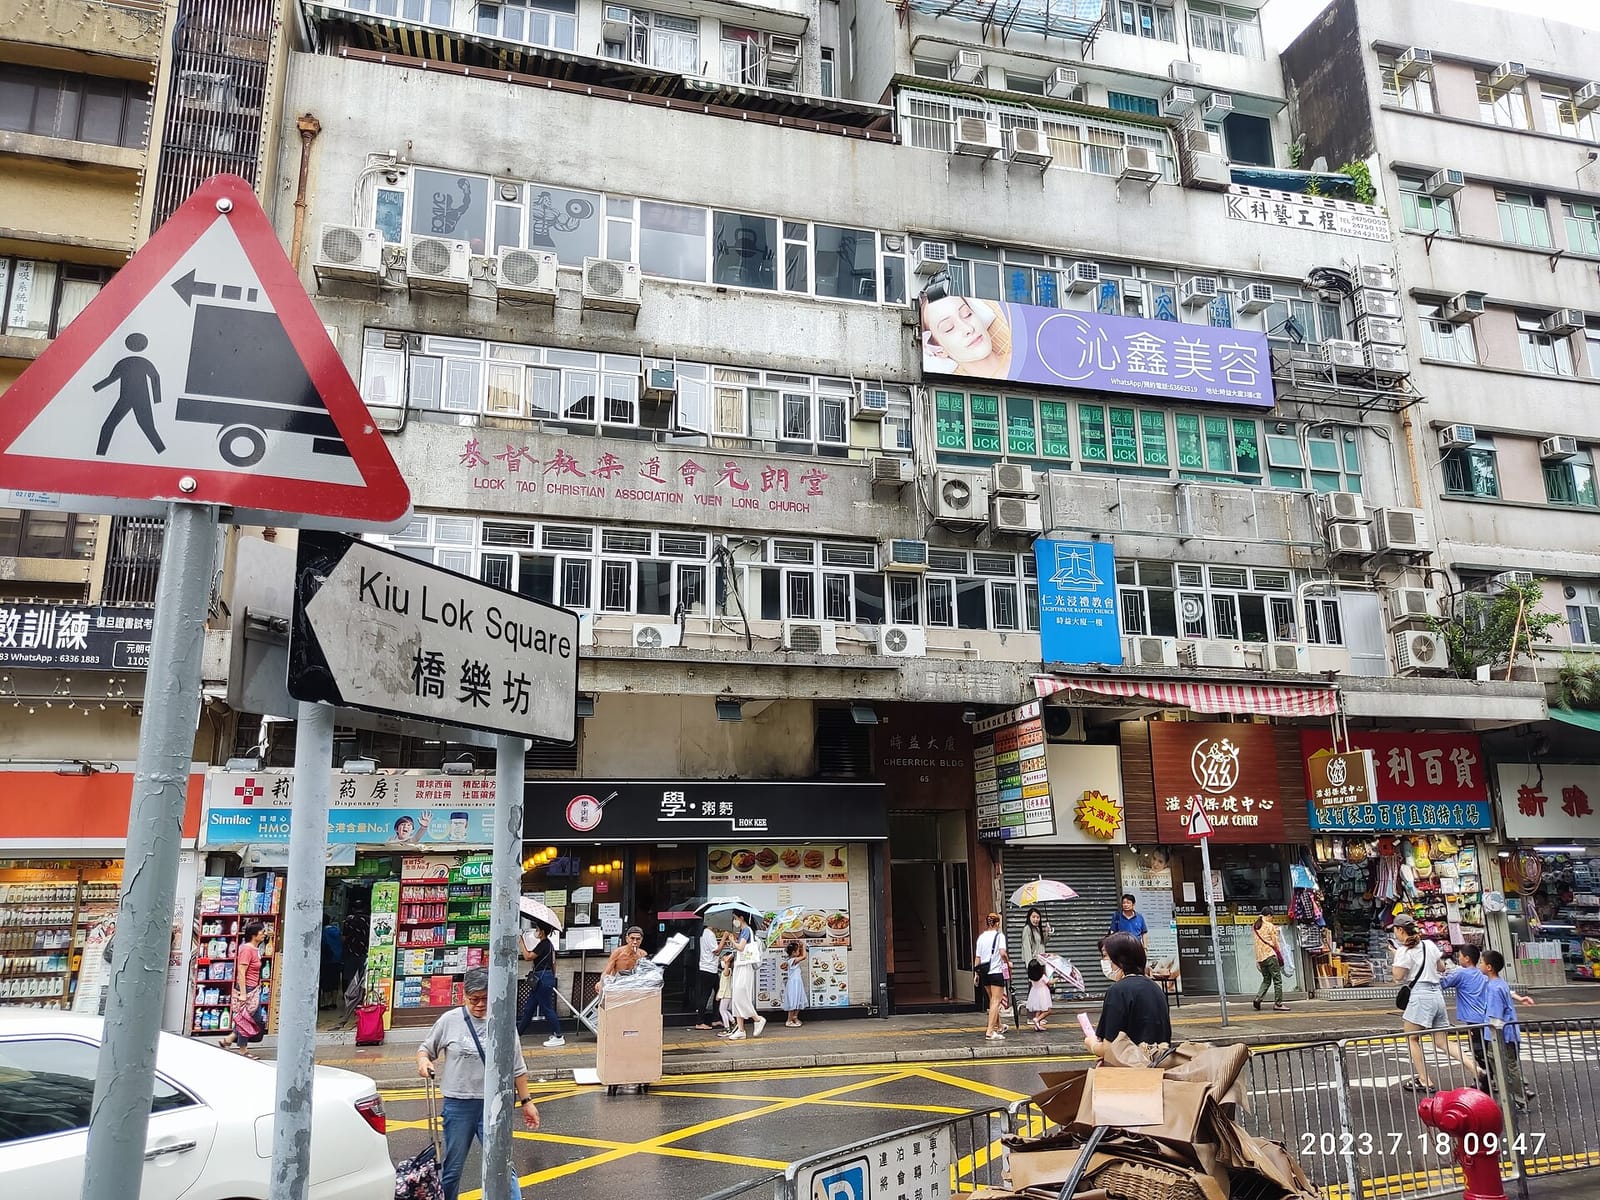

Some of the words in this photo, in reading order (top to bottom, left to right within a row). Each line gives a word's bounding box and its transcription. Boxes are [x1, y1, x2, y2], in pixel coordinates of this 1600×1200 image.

[1250, 200, 1337, 231] 科藝工程
[1076, 323, 1258, 386] 沁鑫美容
[938, 435, 965, 447] JCK
[973, 439, 999, 450] JCK
[1010, 441, 1035, 453] JCK
[1044, 443, 1069, 455] JCK
[1082, 447, 1106, 458] JCK
[1114, 449, 1137, 460] JCK
[1145, 452, 1167, 463] JCK
[1180, 455, 1202, 465] JCK
[473, 477, 505, 490] LOCK
[516, 480, 537, 493] TAO
[546, 483, 606, 499] CHRISTIAN
[614, 488, 684, 504] ASSOCIATION
[693, 494, 723, 507] YUEN
[731, 497, 760, 510] LONG
[769, 500, 811, 513] CHURCH
[359, 566, 410, 615] Kiu
[421, 585, 474, 633] Lok
[485, 606, 571, 659] Square
[1042, 594, 1114, 609] 仁光浸禮教會
[10, 653, 52, 663] WhatsApp
[59, 654, 79, 663] 6336
[80, 655, 100, 663] 1883
[411, 647, 532, 715] 橋樂坊
[883, 758, 936, 767] CHEERRICK
[210, 813, 252, 825] Similac
[258, 824, 290, 833] HMO
[739, 818, 753, 827] HOK
[754, 818, 767, 827] KEE
